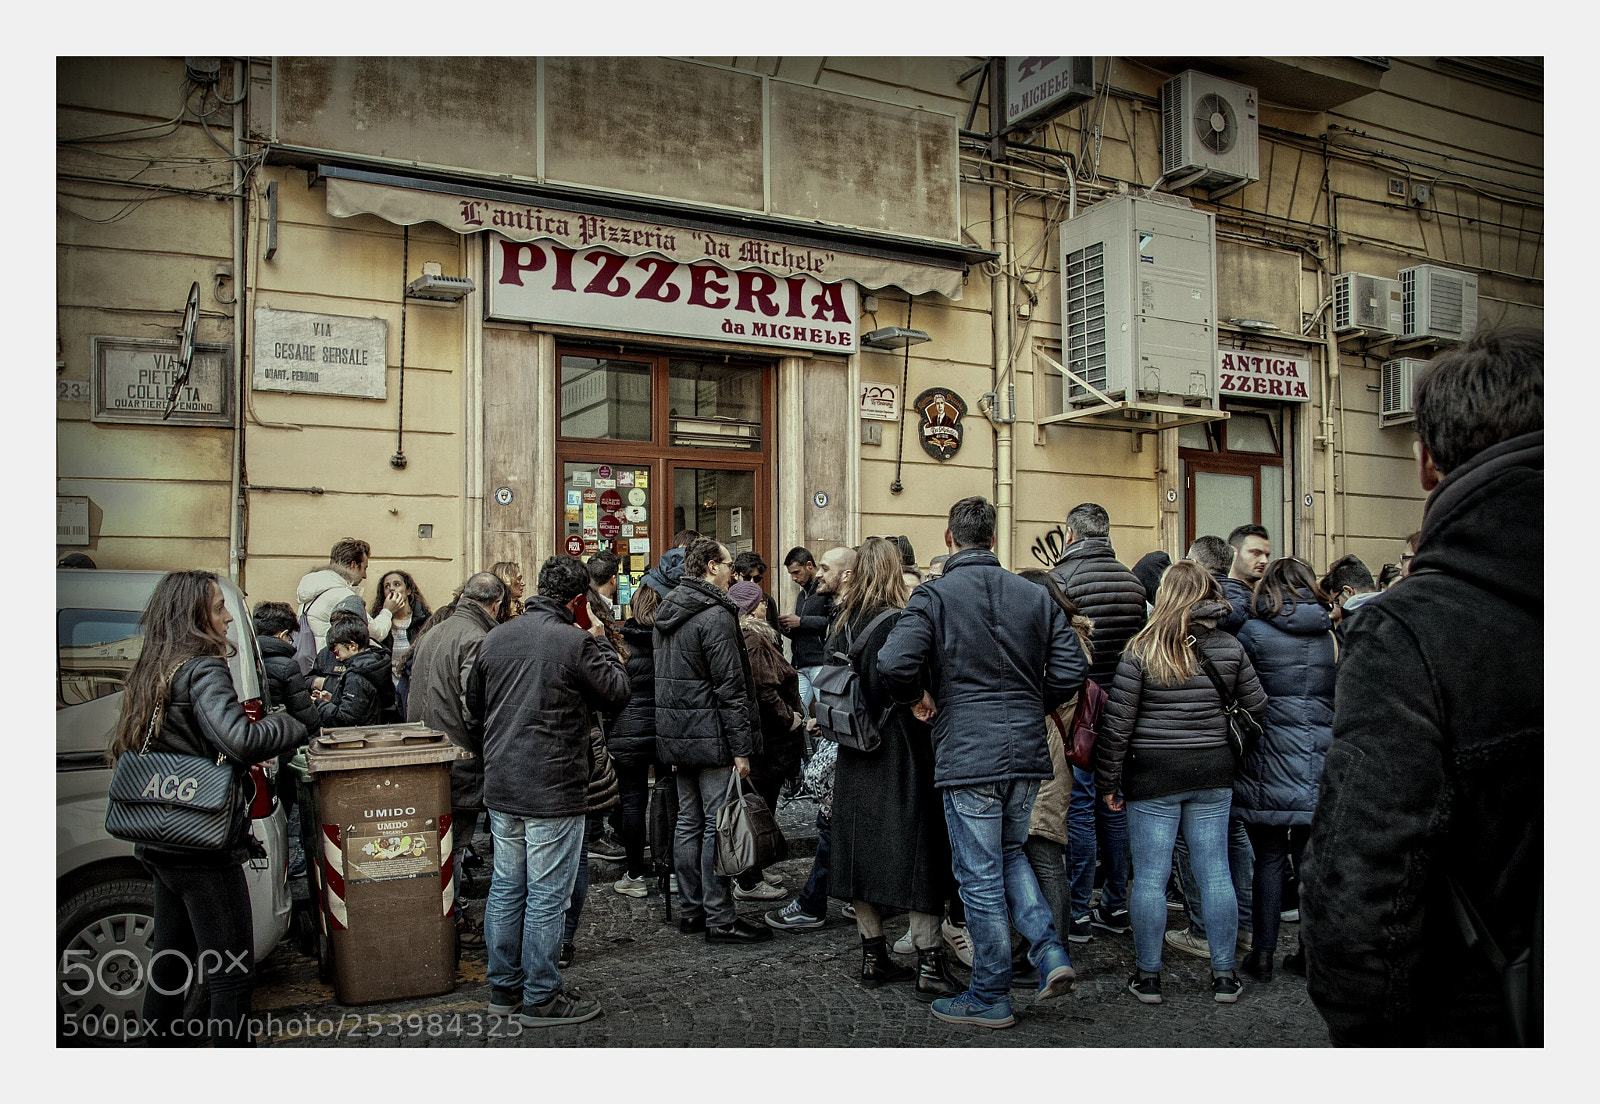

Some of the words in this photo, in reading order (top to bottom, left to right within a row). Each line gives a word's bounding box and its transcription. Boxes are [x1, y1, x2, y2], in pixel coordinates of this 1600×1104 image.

[1009, 103, 1020, 117] da
[1021, 69, 1069, 113] MICHELE
[577, 215, 677, 252] Pizzeria
[499, 239, 852, 324] PIZZERIA
[313, 322, 332, 337] VIA
[721, 318, 746, 335] da
[751, 321, 852, 347] MICHELE
[154, 354, 176, 370] VIA
[274, 342, 316, 362] CESARE
[322, 346, 368, 366] SERSALE
[1221, 353, 1299, 378] ANTICA
[128, 384, 201, 402] COLLETA
[1219, 373, 1309, 398] ZZERIA
[176, 401, 213, 412] ENDINO
[141, 772, 198, 802] ACG
[363, 806, 416, 819] UMIDO
[376, 821, 409, 831] UMIDO
